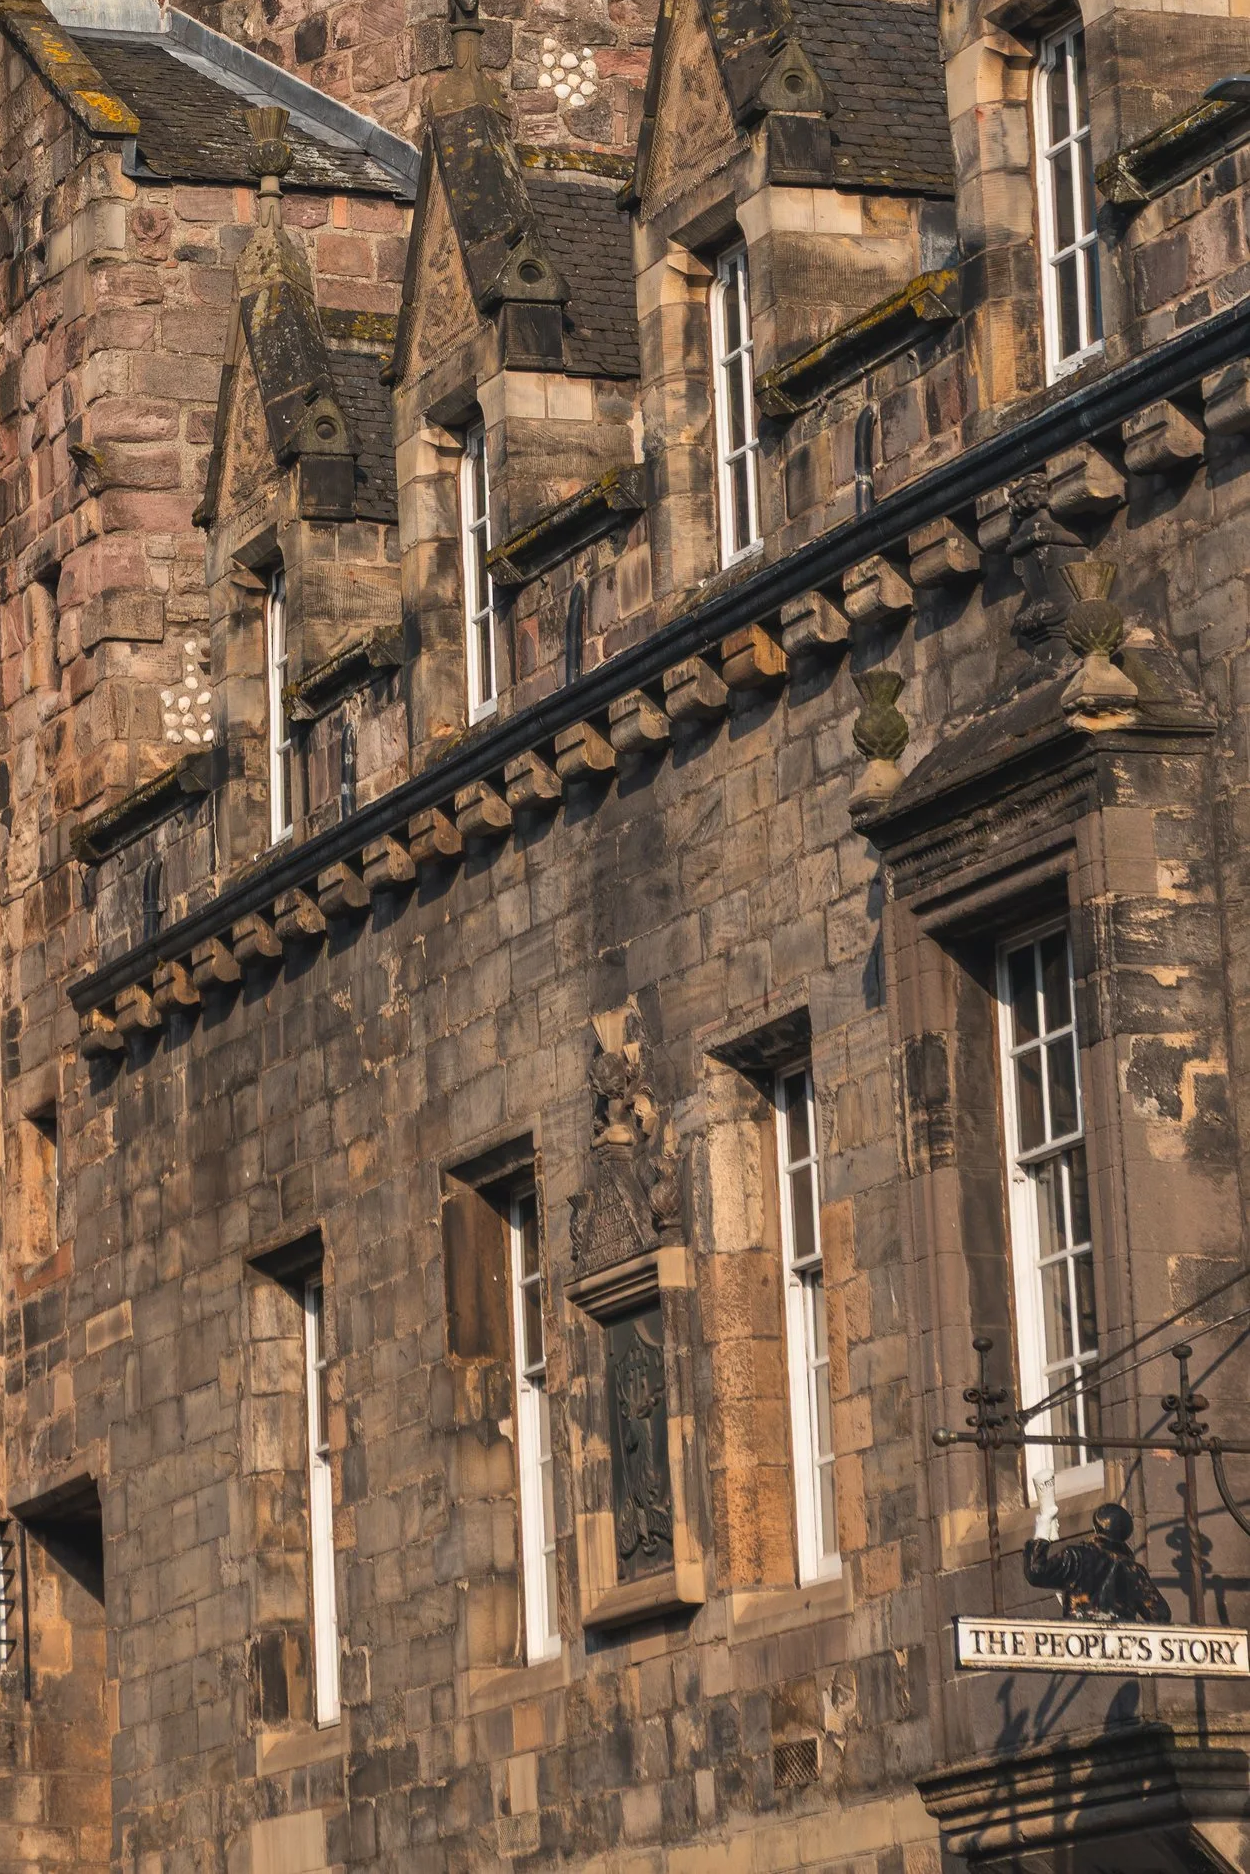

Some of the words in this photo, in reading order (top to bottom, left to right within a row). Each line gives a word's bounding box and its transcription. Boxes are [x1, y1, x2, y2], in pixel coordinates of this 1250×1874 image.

[969, 1629, 1028, 1656] THE
[1034, 1632, 1153, 1662] PEOPLE'S
[1160, 1638, 1240, 1664] STORY
